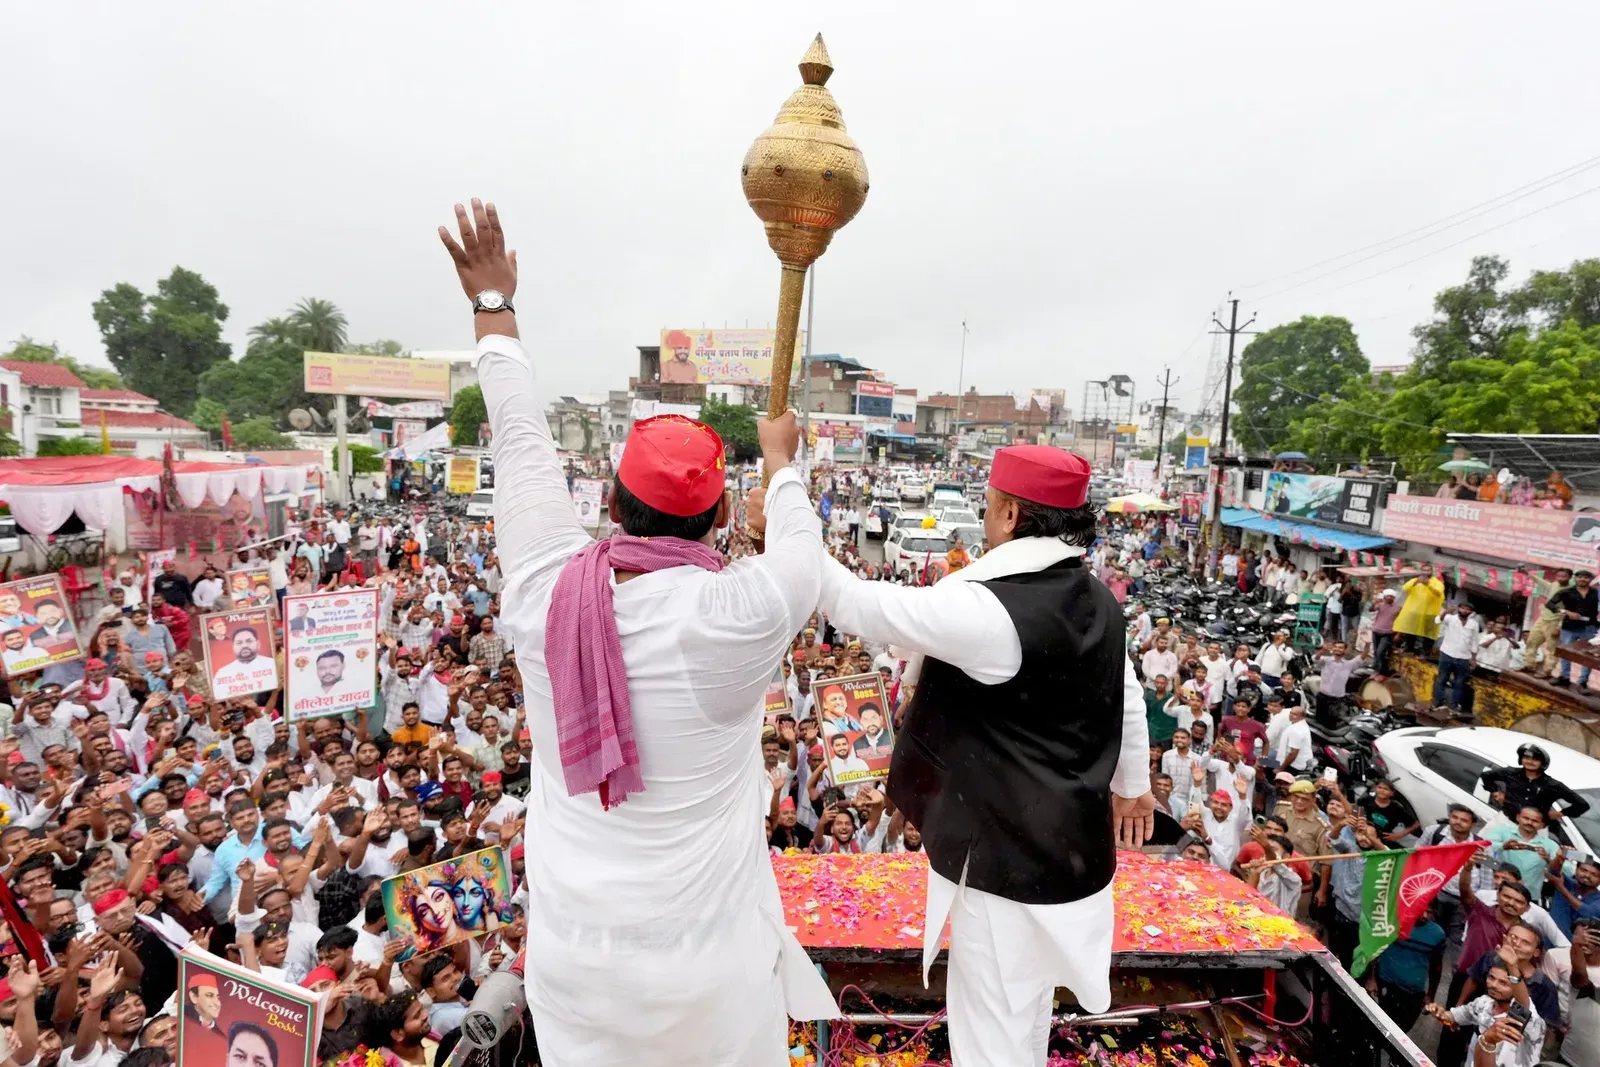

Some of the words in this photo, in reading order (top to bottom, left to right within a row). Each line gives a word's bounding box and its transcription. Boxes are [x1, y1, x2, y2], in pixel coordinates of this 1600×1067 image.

[719, 348, 739, 358] प्रताप
[760, 346, 772, 358] जी
[1350, 482, 1373, 498] AMAN
[1342, 509, 1371, 526] CORNER
[1444, 503, 1481, 522] सर्विस
[841, 681, 877, 692] Welcome
[294, 696, 334, 711] नीलेश
[339, 689, 370, 703] यादव
[1371, 858, 1395, 937] समाजवादी
[224, 980, 304, 1023] Welcome
